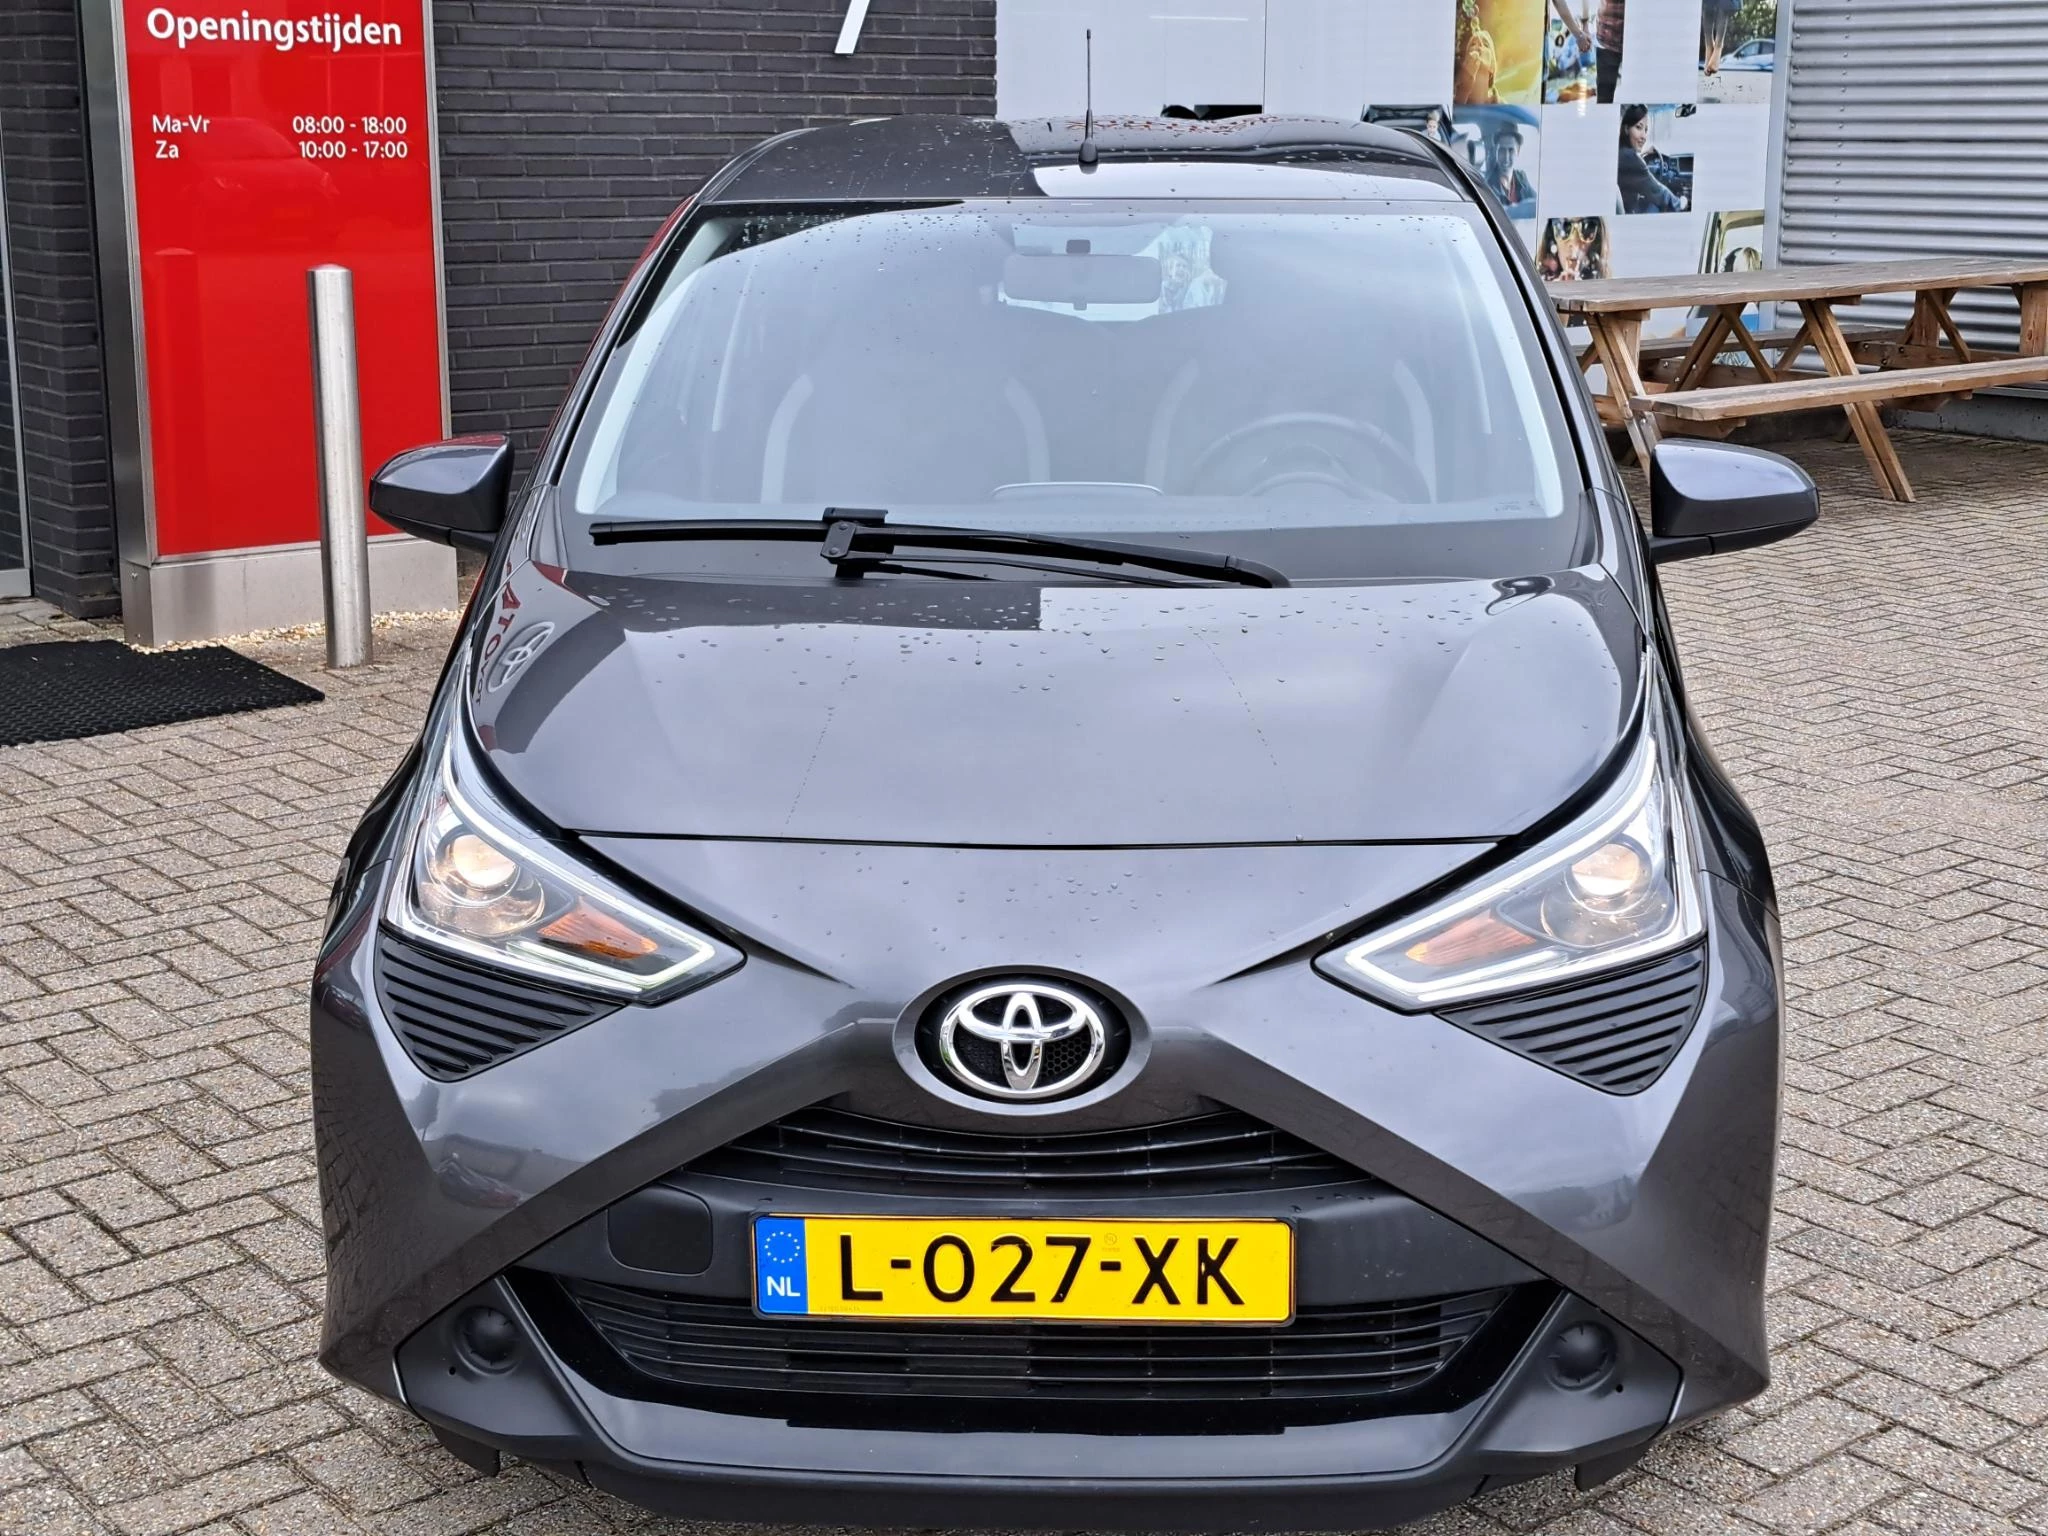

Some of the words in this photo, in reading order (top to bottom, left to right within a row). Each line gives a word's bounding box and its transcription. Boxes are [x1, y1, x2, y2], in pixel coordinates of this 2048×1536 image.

[146, 7, 402, 52] Openingstijden
[152, 114, 210, 134] Ma-Vr
[292, 115, 345, 134] 08:00
[361, 115, 407, 135] 18:00
[155, 139, 179, 159] Za
[298, 140, 347, 159] 10:00
[363, 140, 408, 159] 17:00
[840, 1234, 1245, 1305] L-027-XK
[766, 1275, 801, 1298] NL
